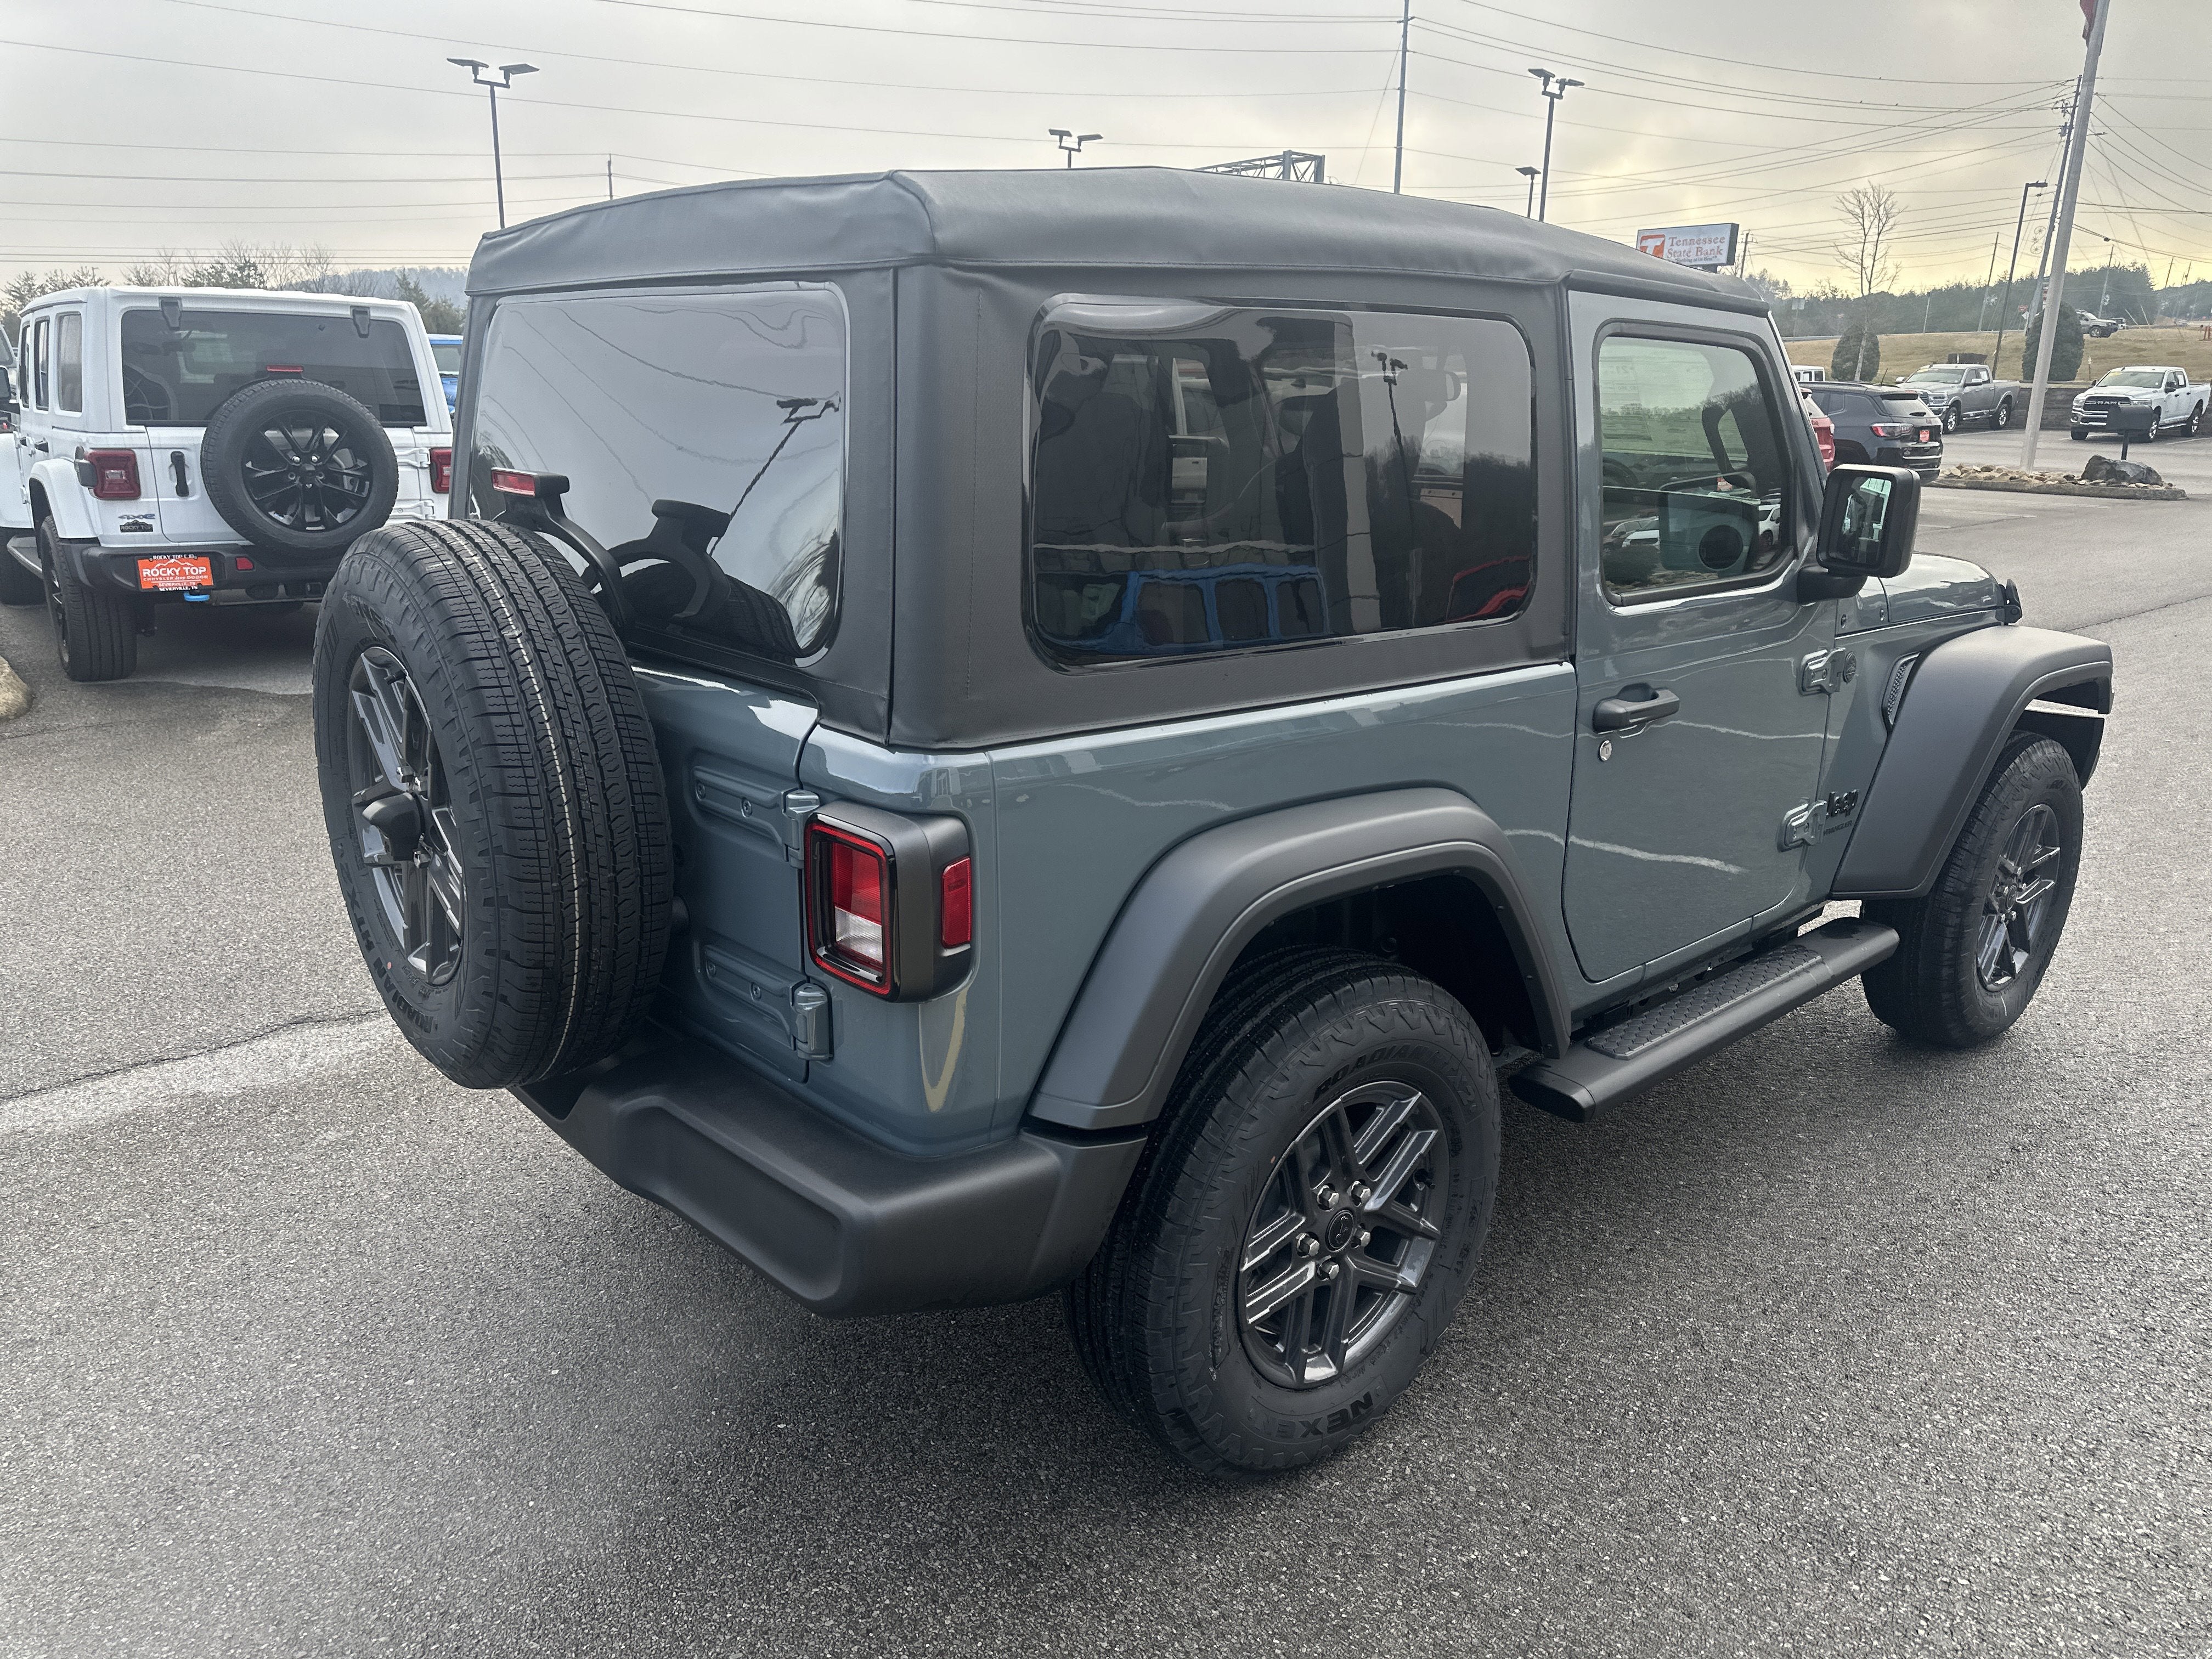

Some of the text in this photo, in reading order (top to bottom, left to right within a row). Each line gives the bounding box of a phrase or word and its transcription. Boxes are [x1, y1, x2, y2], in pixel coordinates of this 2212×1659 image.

[1668, 236, 1725, 246] Tennessee
[1667, 245, 1723, 258] State Bank
[142, 566, 207, 577] ROCKY TOP
[1826, 789, 1859, 820] Jeep
